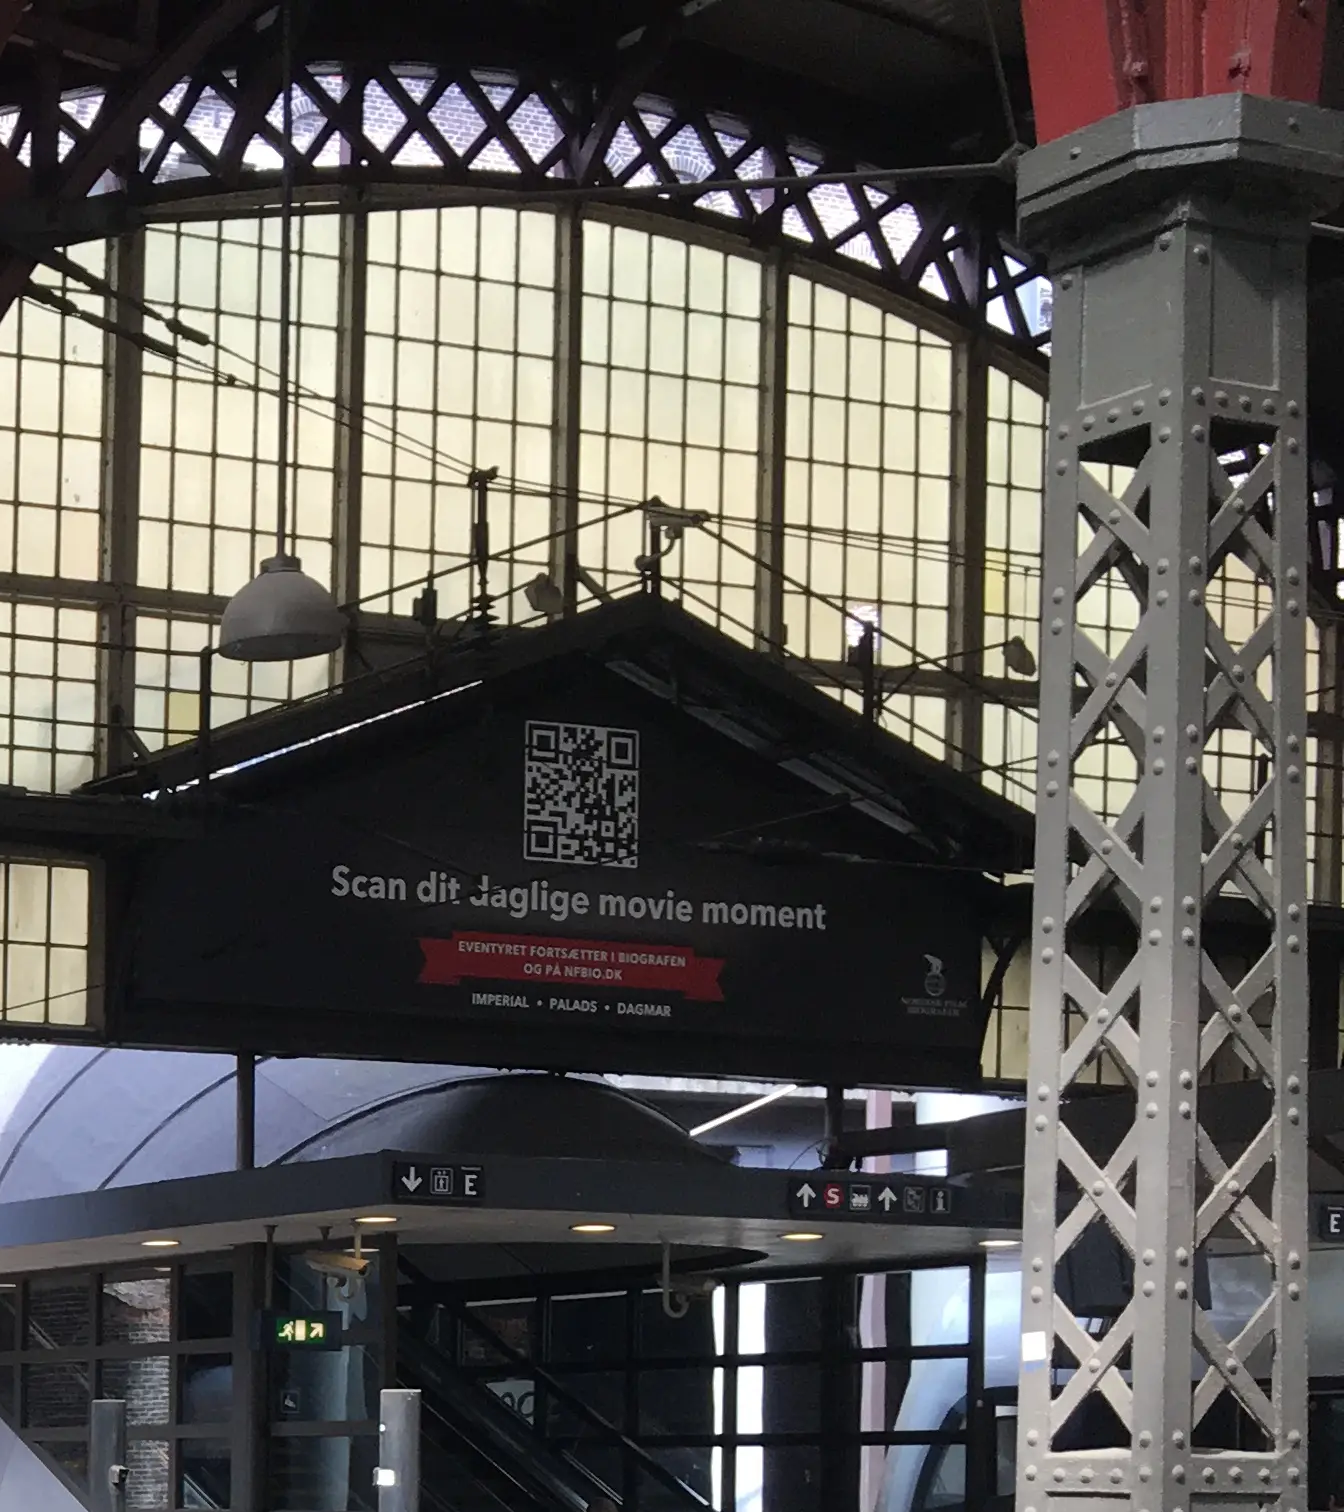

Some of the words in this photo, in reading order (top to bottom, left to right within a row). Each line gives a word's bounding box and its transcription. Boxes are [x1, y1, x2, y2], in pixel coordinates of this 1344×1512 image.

[331, 864, 407, 901] Scan
[416, 871, 461, 905] dit
[469, 874, 591, 922] daglige
[598, 890, 693, 923] movie
[702, 899, 827, 931] moment
[458, 940, 528, 957] EVENTYRET
[530, 945, 609, 962] FORTSÆTTER
[618, 952, 687, 968] BIOGRAFEN
[523, 962, 542, 975] OG
[545, 962, 561, 977] PÅ
[564, 965, 623, 981] NFBIO.DK
[471, 992, 530, 1009] IMPERIAL
[549, 998, 598, 1013] PALADS
[616, 1002, 672, 1018] DAGMAR
[464, 1174, 478, 1195] E
[826, 1188, 841, 1205] S
[1330, 1213, 1341, 1233] E
